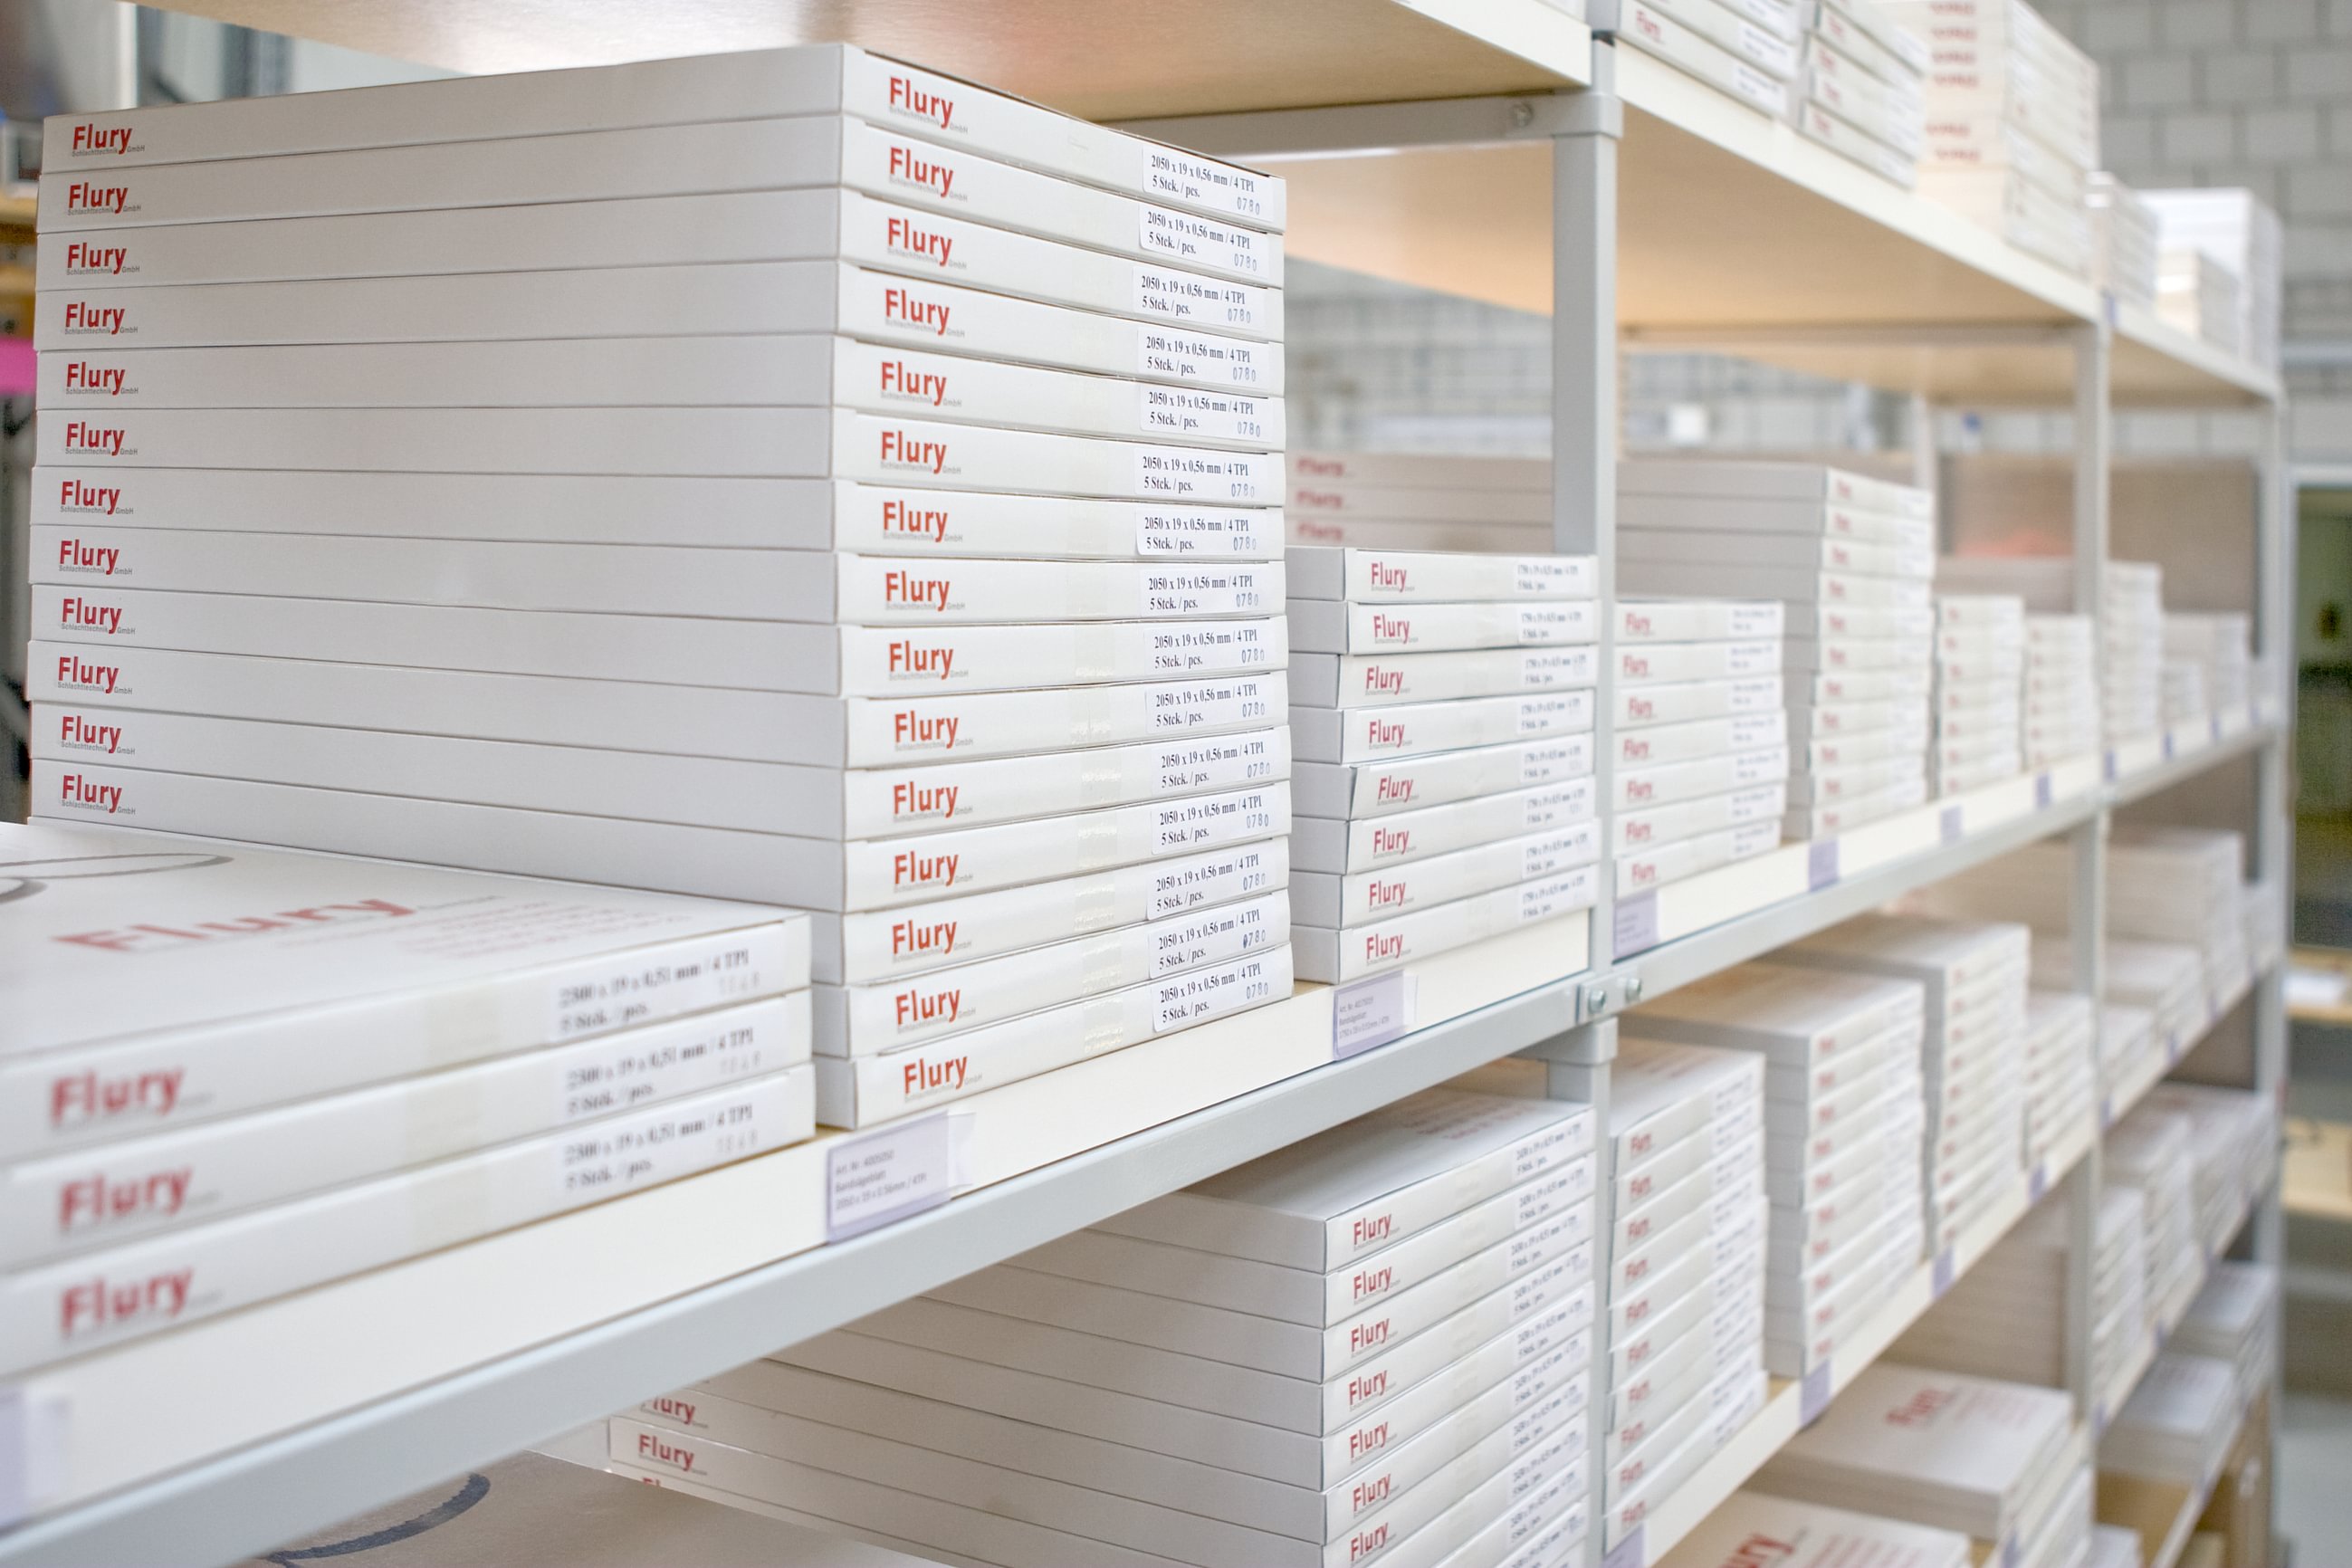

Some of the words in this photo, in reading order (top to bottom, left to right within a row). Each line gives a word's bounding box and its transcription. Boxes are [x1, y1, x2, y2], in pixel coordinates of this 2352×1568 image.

[889, 76, 953, 130] Flury
[72, 122, 132, 156] Flury
[889, 145, 954, 198] Flury
[68, 181, 129, 215] Flury
[887, 216, 952, 267] Flury
[1148, 212, 1166, 227] 2050
[1168, 220, 1172, 229] x
[1175, 219, 1183, 232] 19
[1186, 225, 1190, 234] x
[1192, 224, 1208, 238] 0,56
[1209, 232, 1223, 243] mm
[1229, 234, 1234, 245] 4
[1236, 234, 1249, 249] TPI
[1149, 232, 1153, 244] 5
[1155, 233, 1175, 249] Stck.
[1181, 243, 1196, 254] pcs.
[66, 242, 127, 276] Flury
[1234, 253, 1257, 272] 0780
[65, 302, 126, 336] Flury
[884, 289, 951, 337] Flury
[66, 361, 126, 397] Flury
[881, 361, 947, 406] Flury
[1149, 391, 1167, 406] 2050
[1170, 397, 1174, 406] x
[1177, 395, 1185, 407] 19
[1188, 399, 1192, 408] x
[1194, 397, 1210, 411] 0,56
[1212, 402, 1227, 412] mm
[1233, 401, 1238, 413] 4
[1239, 402, 1253, 415] TPI
[1150, 411, 1155, 424] 5
[1157, 412, 1177, 425] Stck.
[1184, 418, 1198, 430] pcs.
[1238, 421, 1260, 437] 0780
[65, 420, 126, 457] Flury
[881, 430, 947, 474] Flury
[60, 478, 121, 516] Flury
[883, 499, 948, 543] Flury
[1145, 517, 1163, 530] 2050
[1165, 521, 1171, 530] x
[1173, 518, 1181, 530] 19
[1183, 521, 1188, 531] x
[1190, 518, 1206, 531] 0,56
[1208, 522, 1222, 531] mm
[1229, 520, 1233, 531] 4
[1235, 520, 1248, 531] TPI
[59, 539, 120, 576] Flury
[1146, 537, 1152, 549] 5
[1153, 537, 1172, 550] Stck.
[1180, 540, 1194, 553] pcs.
[1233, 536, 1257, 551] 0780
[884, 570, 950, 612] Flury
[1149, 578, 1167, 590] 2050
[1170, 581, 1174, 589] x
[1177, 577, 1185, 589] 19
[1188, 580, 1192, 589] x
[1194, 576, 1209, 590] 0,56
[1211, 579, 1226, 588] mm
[1232, 576, 1237, 587] 4
[1238, 575, 1252, 588] TPI
[1370, 561, 1407, 592] Flury
[62, 597, 122, 636] Flury
[1150, 598, 1155, 610] 5
[1156, 597, 1177, 609] Stck.
[1183, 599, 1198, 612] pcs.
[1236, 593, 1258, 608] 0780
[1372, 614, 1410, 644] Flury
[57, 655, 120, 695] Flury
[888, 640, 953, 681] Flury
[1365, 665, 1404, 698] Flury
[61, 714, 121, 755] Flury
[894, 710, 959, 750] Flury
[1368, 719, 1406, 750] Flury
[62, 773, 122, 814] Flury
[893, 781, 958, 819] Flury
[1378, 776, 1413, 803] Flury
[1160, 810, 1178, 826] 2050
[1181, 813, 1185, 822] x
[1188, 807, 1196, 820] 19
[1198, 809, 1203, 818] x
[1204, 803, 1220, 817] 0,56
[1222, 804, 1236, 814] mm
[1242, 798, 1247, 809] 4
[1248, 795, 1262, 808] TPI
[1247, 813, 1268, 828] 0780
[1162, 833, 1166, 846] 5
[1168, 829, 1188, 844] Stck.
[1195, 828, 1209, 841] pcs.
[1372, 828, 1410, 856] Flury
[894, 850, 959, 885] Flury
[1368, 882, 1407, 906] Flury
[52, 897, 416, 951] Flury
[892, 920, 957, 955] Flury
[1365, 934, 1403, 960] Flury
[895, 989, 961, 1026] Flury
[903, 1056, 968, 1095] Flury
[50, 1067, 185, 1127] Flury
[59, 1165, 195, 1230] Flury
[1353, 1214, 1391, 1244] Flury
[1353, 1267, 1391, 1296] Flury
[60, 1269, 195, 1337] Flury
[1350, 1319, 1389, 1350] Flury
[1348, 1371, 1387, 1402] Flury
[653, 1397, 695, 1426] lury
[638, 1433, 694, 1472] Flury
[1349, 1422, 1388, 1457] Flury
[1353, 1475, 1391, 1509] Flury
[1350, 1524, 1388, 1562] Flury
